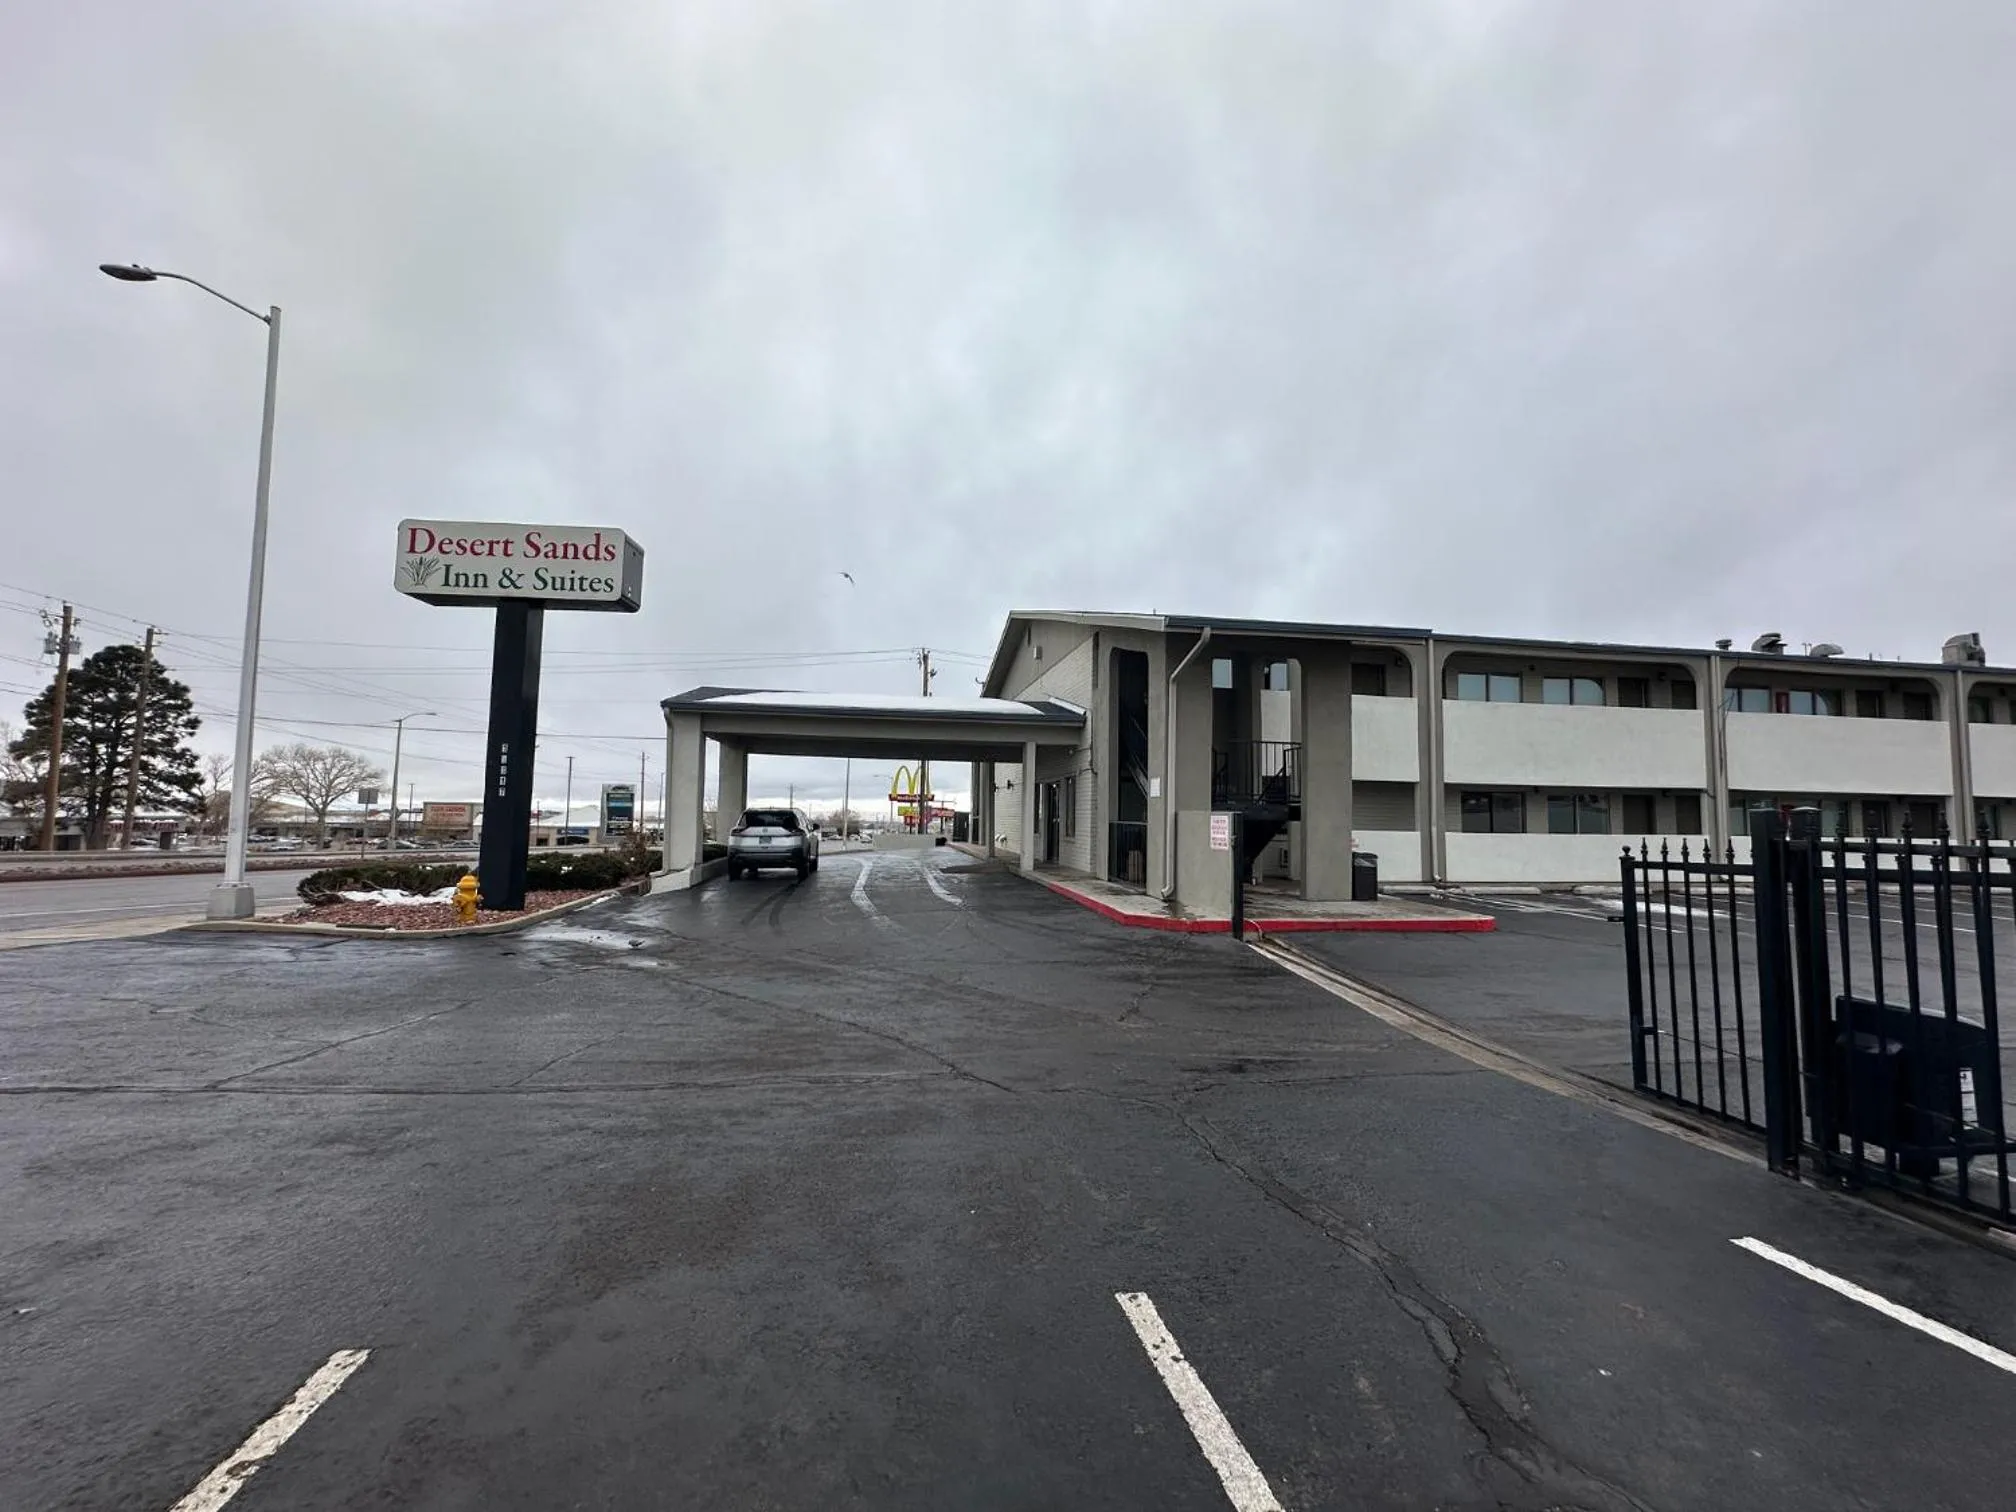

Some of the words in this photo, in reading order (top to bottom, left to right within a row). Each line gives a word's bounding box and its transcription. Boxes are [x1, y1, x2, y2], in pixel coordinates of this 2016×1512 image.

[406, 528, 514, 557] Desert
[523, 532, 616, 562] Sands
[441, 564, 488, 588] Inn
[499, 567, 525, 590] &
[533, 567, 614, 593] Suites
